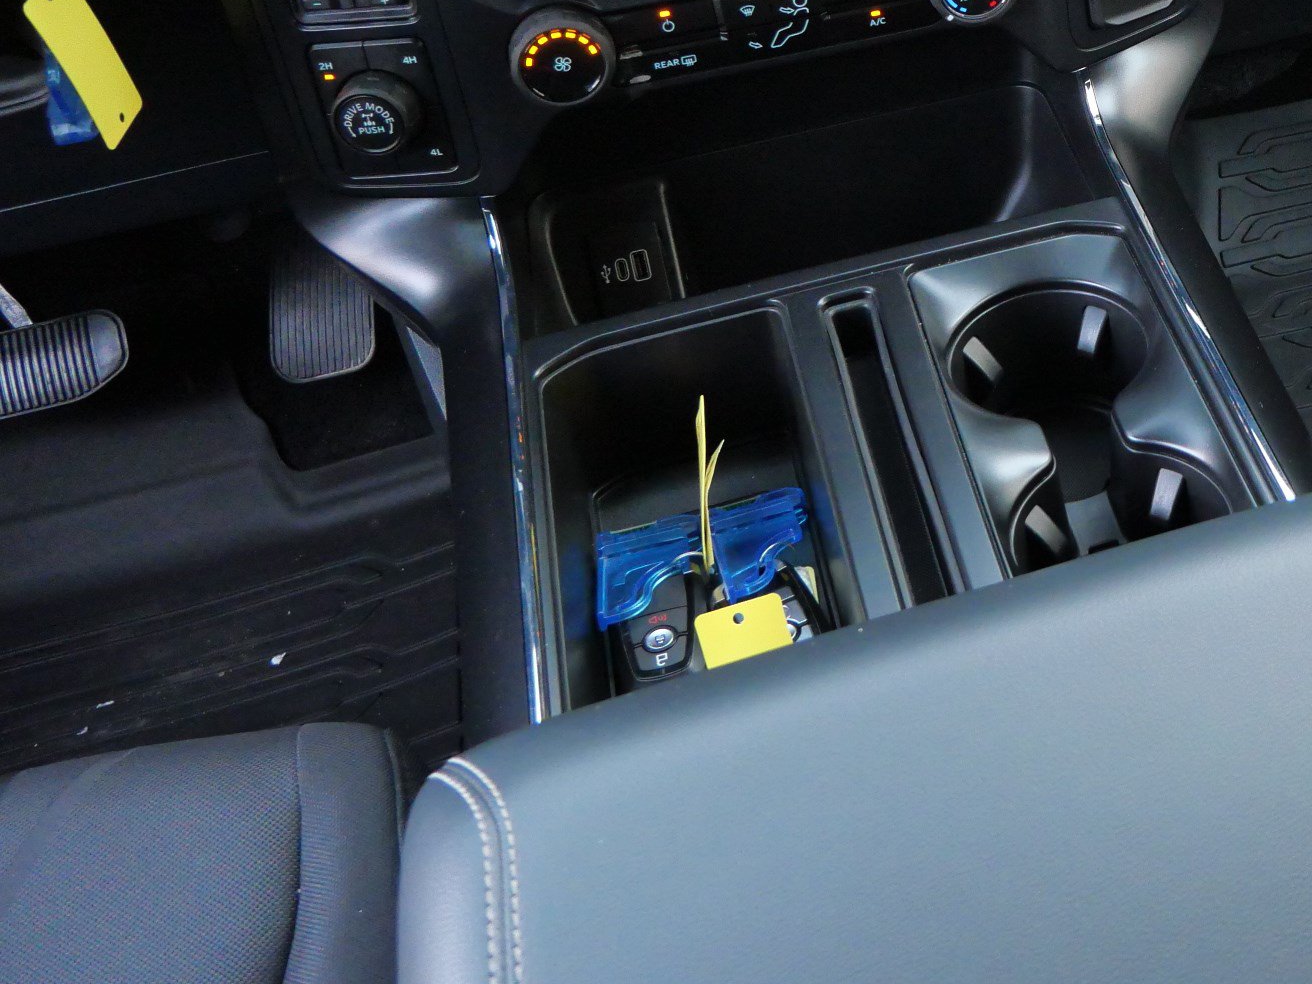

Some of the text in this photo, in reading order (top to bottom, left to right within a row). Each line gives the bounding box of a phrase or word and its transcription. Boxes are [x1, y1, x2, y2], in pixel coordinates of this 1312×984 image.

[870, 17, 887, 27] A/C
[402, 56, 417, 64] 4H
[654, 59, 680, 70] REAR
[318, 62, 333, 70] 2H
[344, 102, 395, 127] DRIVE MODE
[358, 126, 385, 135] PUSH
[430, 148, 443, 156] 4L
